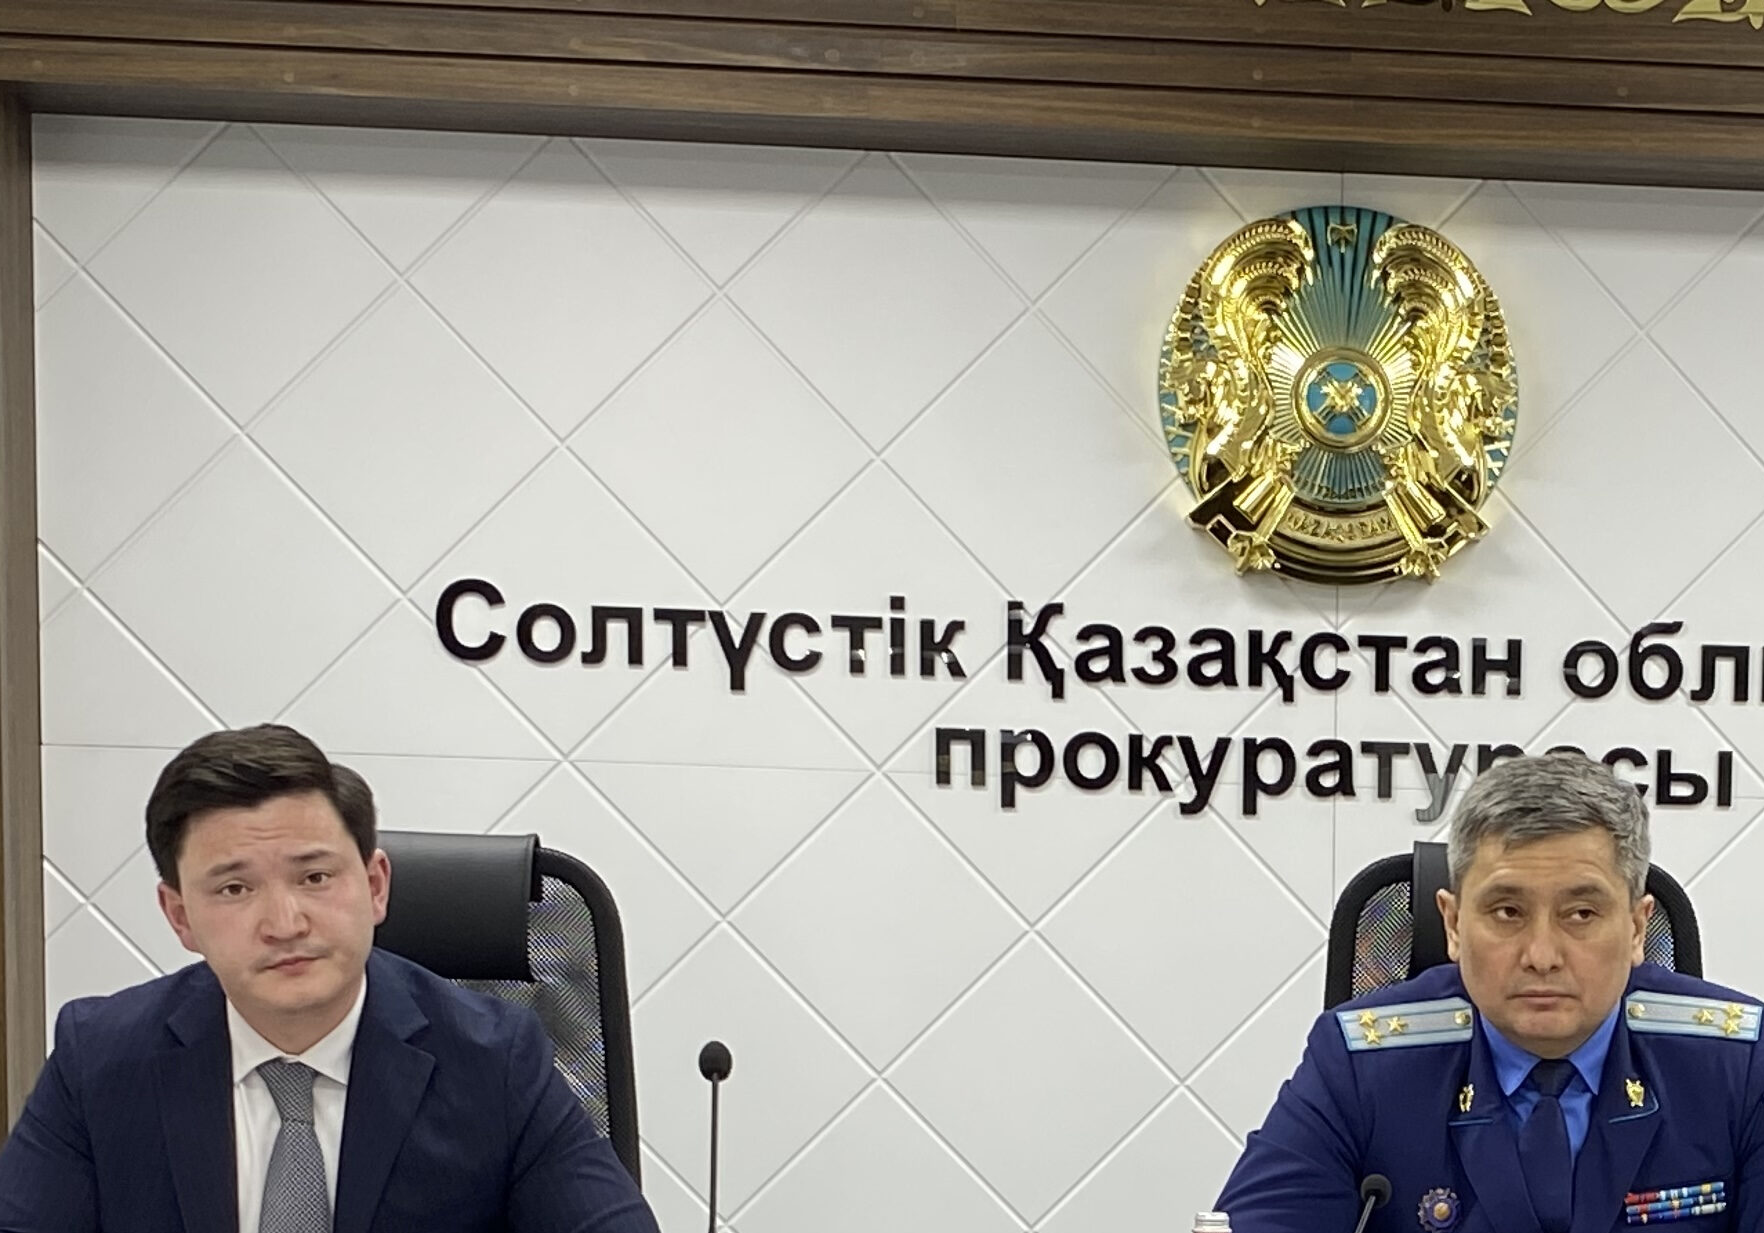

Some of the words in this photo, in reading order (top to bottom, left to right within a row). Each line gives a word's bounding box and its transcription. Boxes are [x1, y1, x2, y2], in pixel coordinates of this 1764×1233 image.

[436, 578, 966, 692] Солтүстік
[1006, 600, 1523, 703] Қазақстан
[935, 727, 1733, 821] прокуратусы
